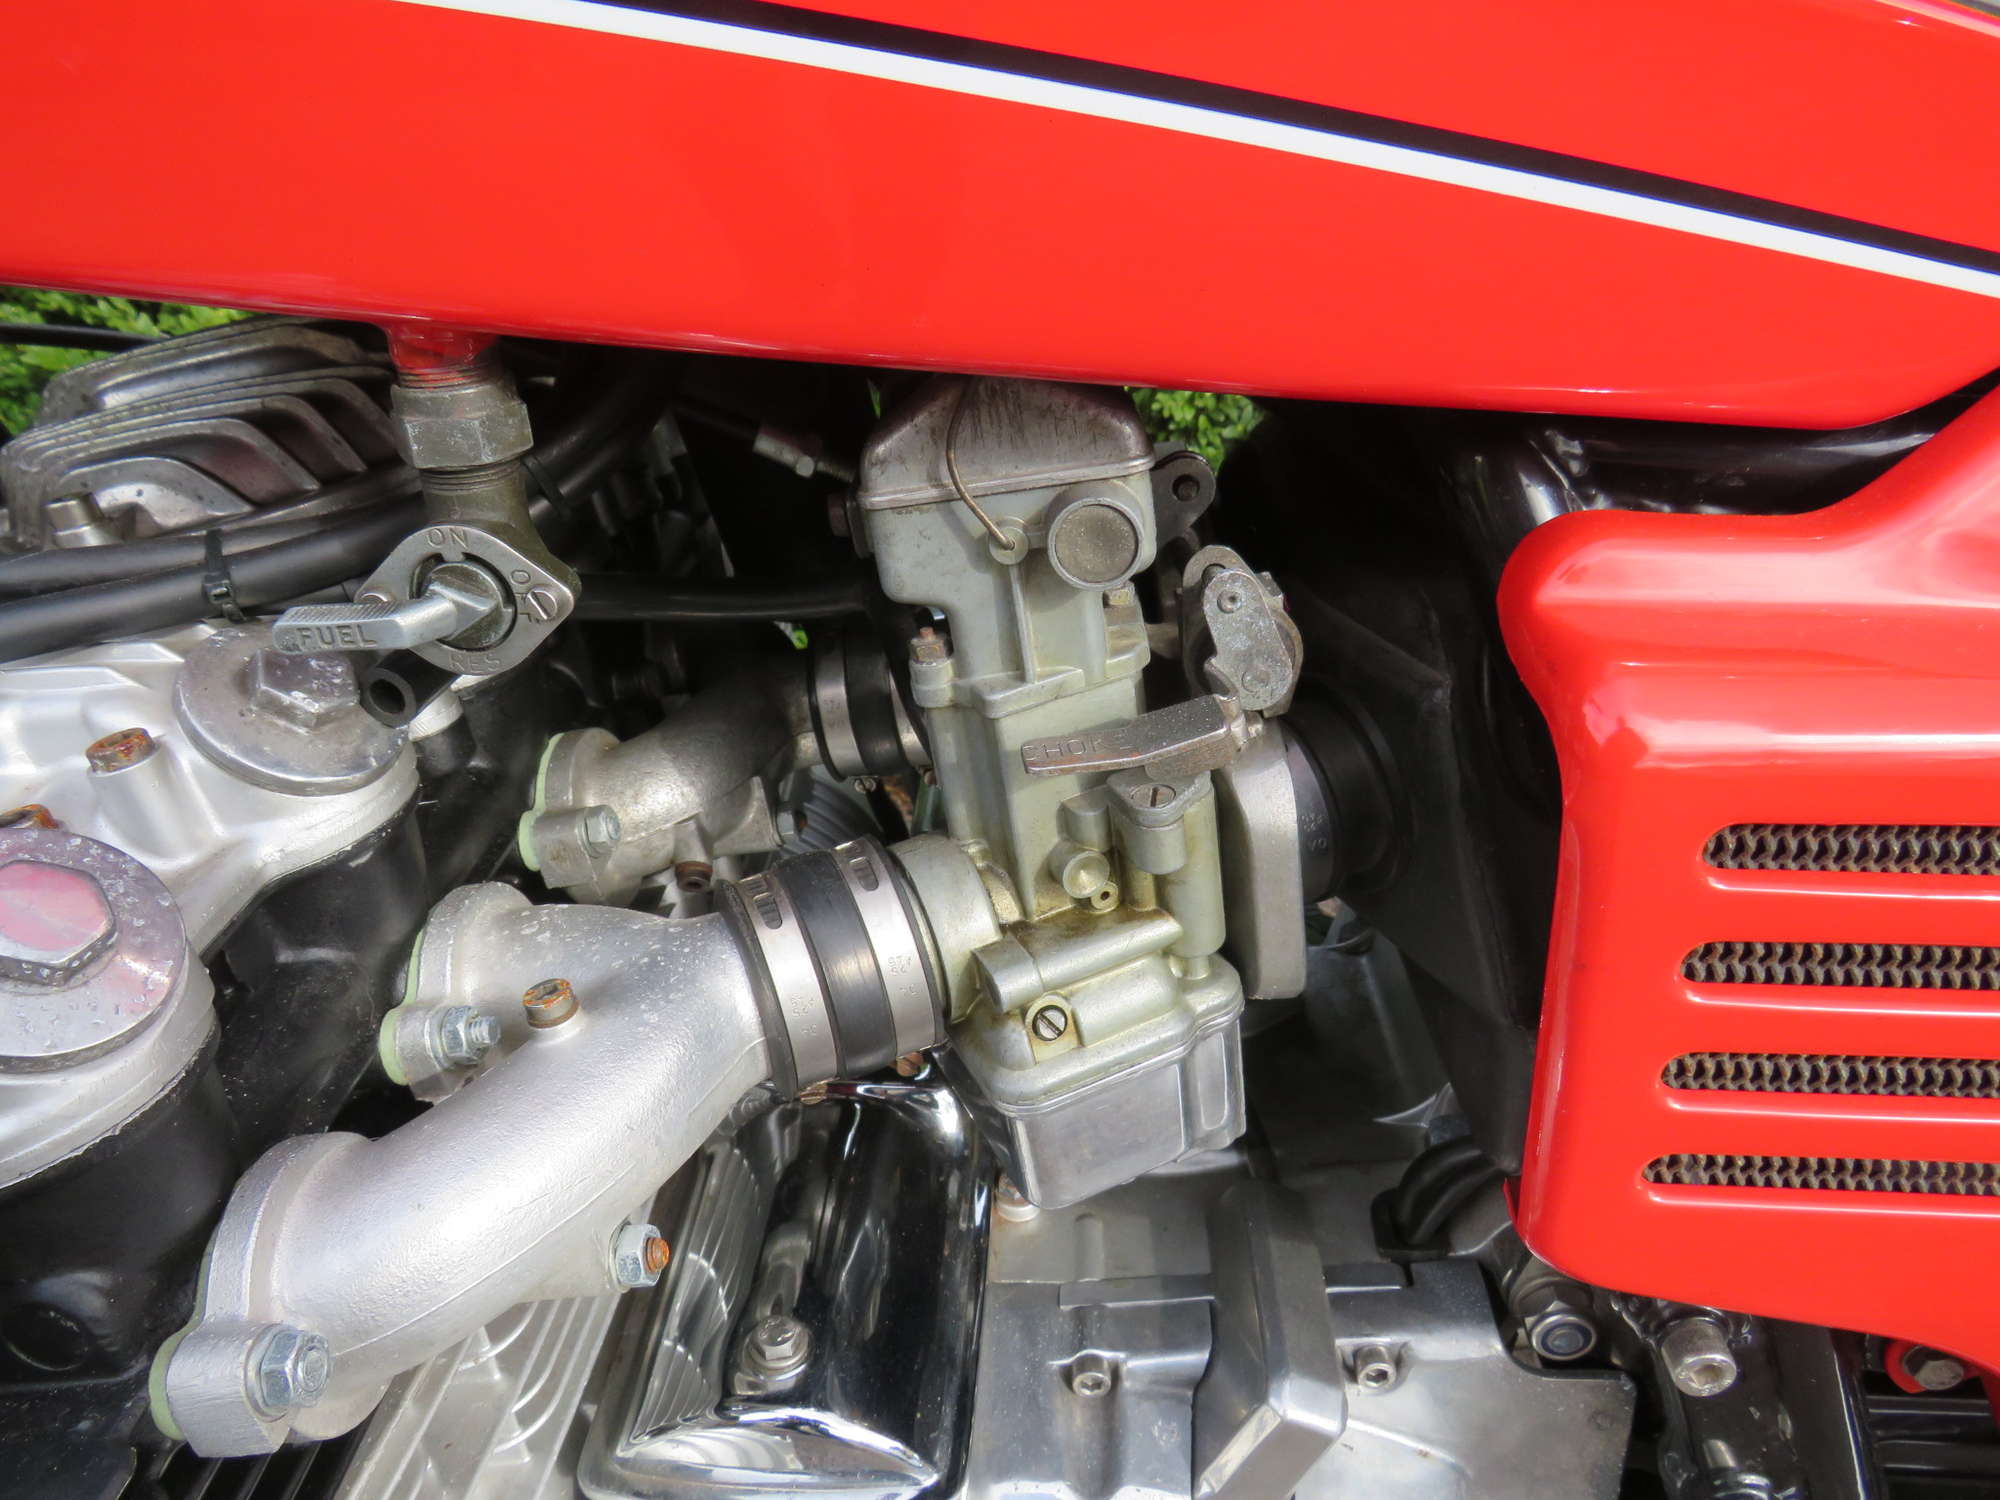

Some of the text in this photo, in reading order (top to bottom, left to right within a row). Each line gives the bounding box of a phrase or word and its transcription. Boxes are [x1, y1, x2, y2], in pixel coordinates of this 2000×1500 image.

[426, 527, 469, 549] ON
[296, 623, 378, 648] FUEL
[450, 653, 501, 673] RES
[1020, 728, 1137, 761] CHOKE
